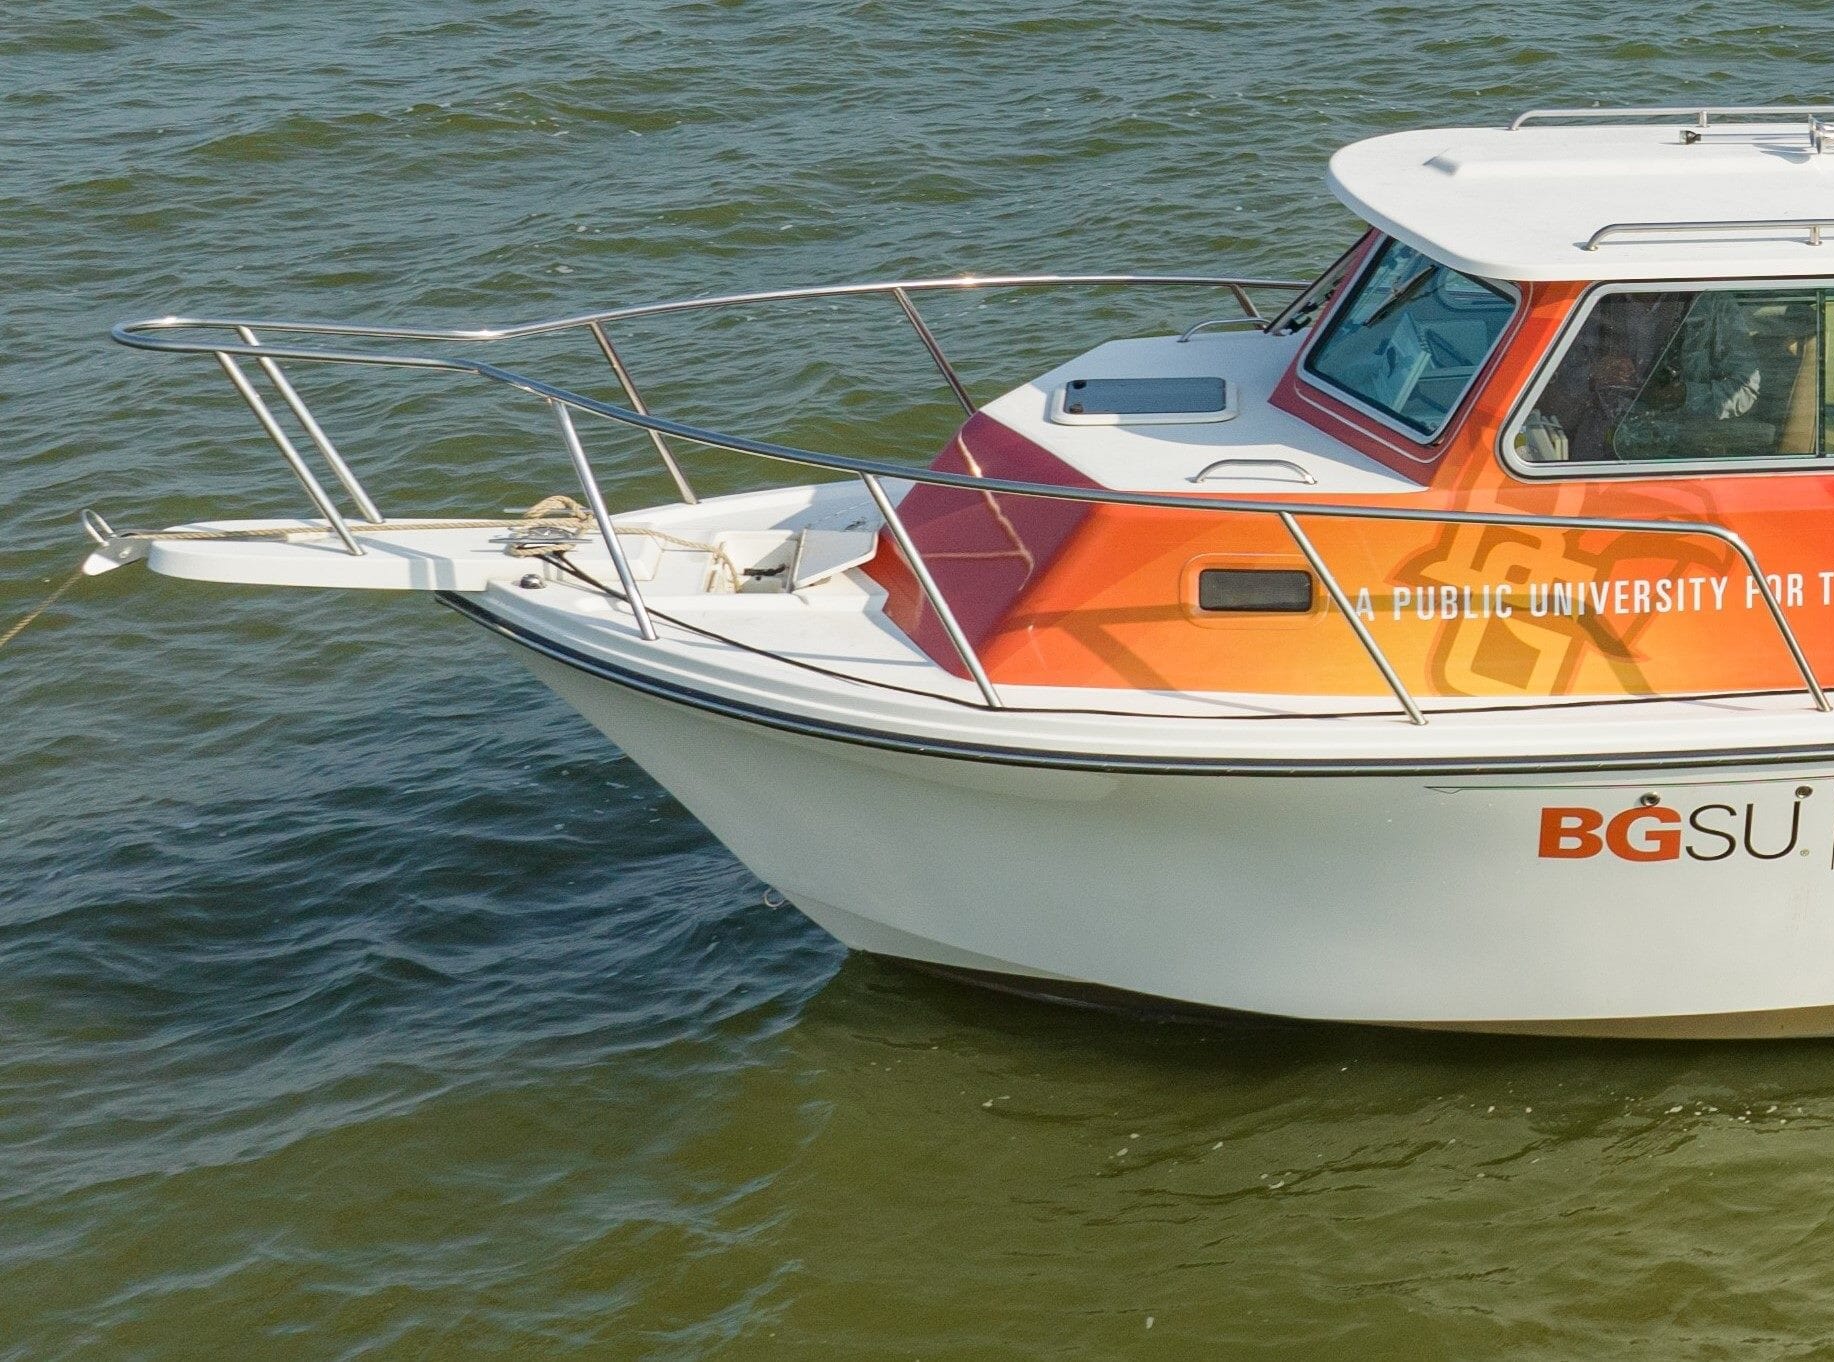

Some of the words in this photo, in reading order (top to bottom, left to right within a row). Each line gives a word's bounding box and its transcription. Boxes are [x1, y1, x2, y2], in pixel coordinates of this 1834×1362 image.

[1355, 587, 1376, 622] A
[1393, 584, 1513, 622] PUBLIC
[1529, 575, 1728, 618] UNIVERSITY
